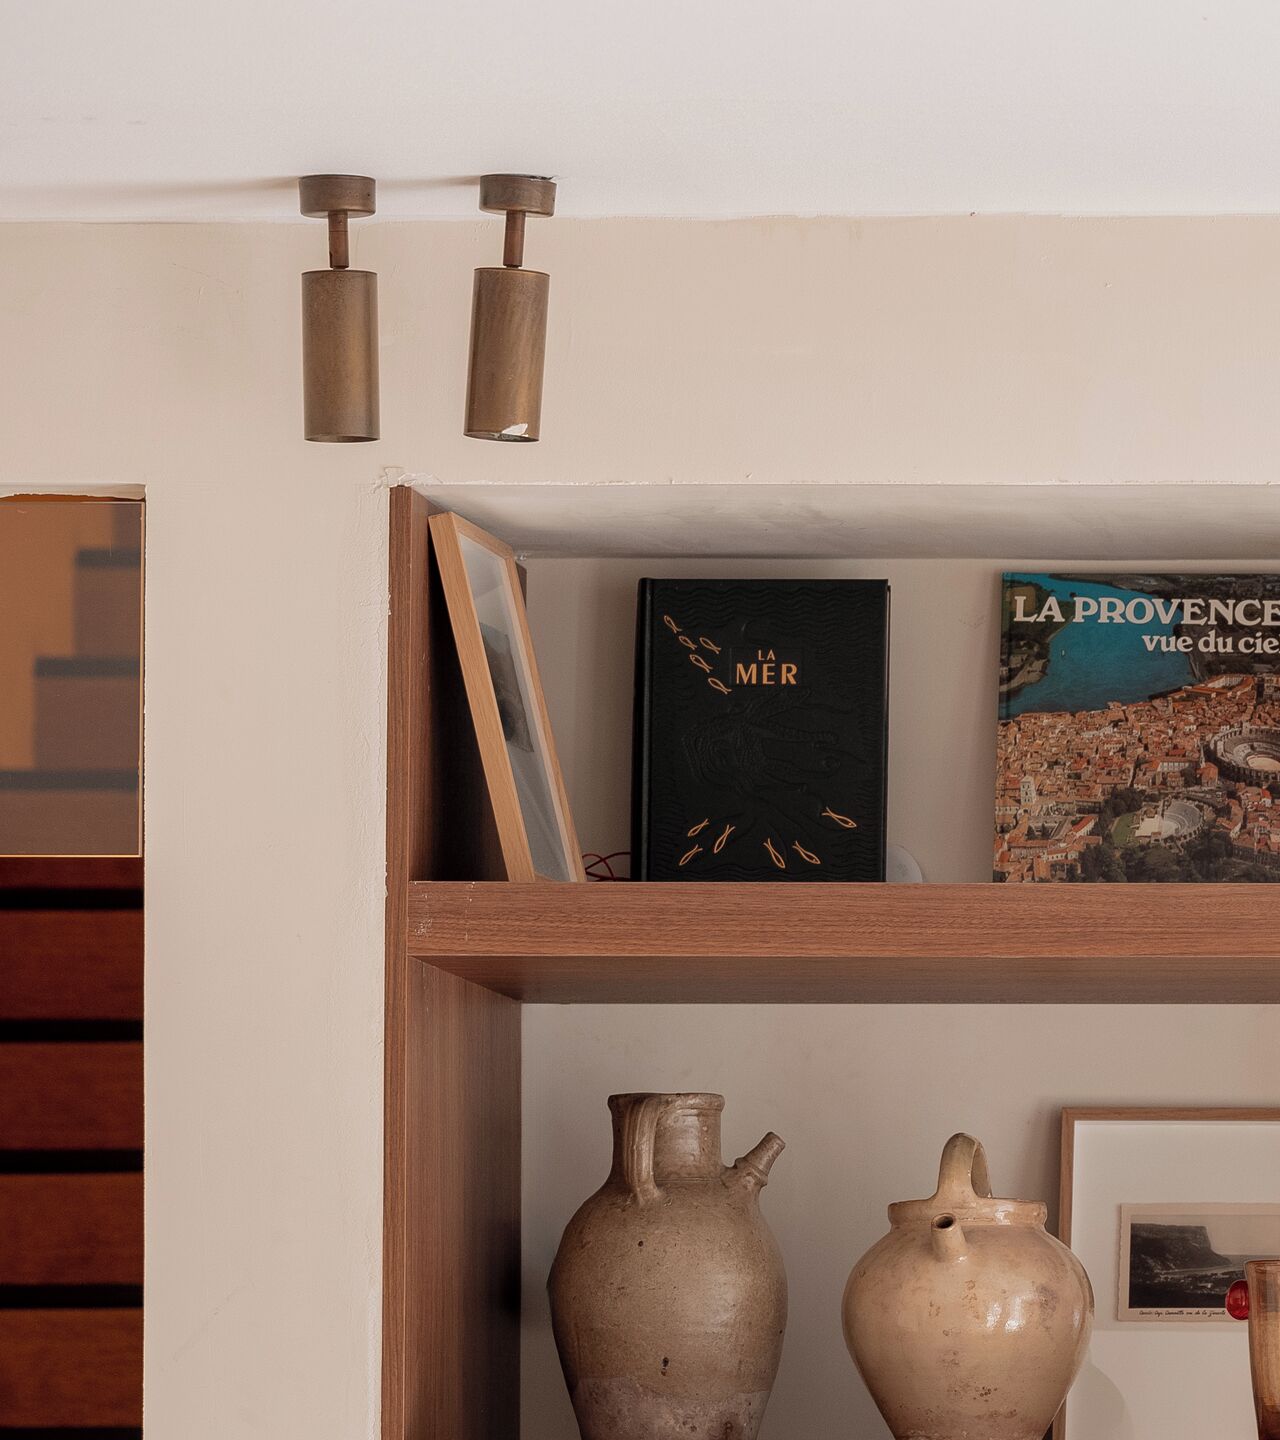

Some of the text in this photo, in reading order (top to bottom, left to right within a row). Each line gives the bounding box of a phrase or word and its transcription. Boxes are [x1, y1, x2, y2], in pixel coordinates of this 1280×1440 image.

[1013, 596, 1065, 623] LA
[1141, 635, 1194, 652] vue
[1198, 629, 1234, 653] du
[758, 649, 776, 661] LA
[736, 663, 798, 685] MER
